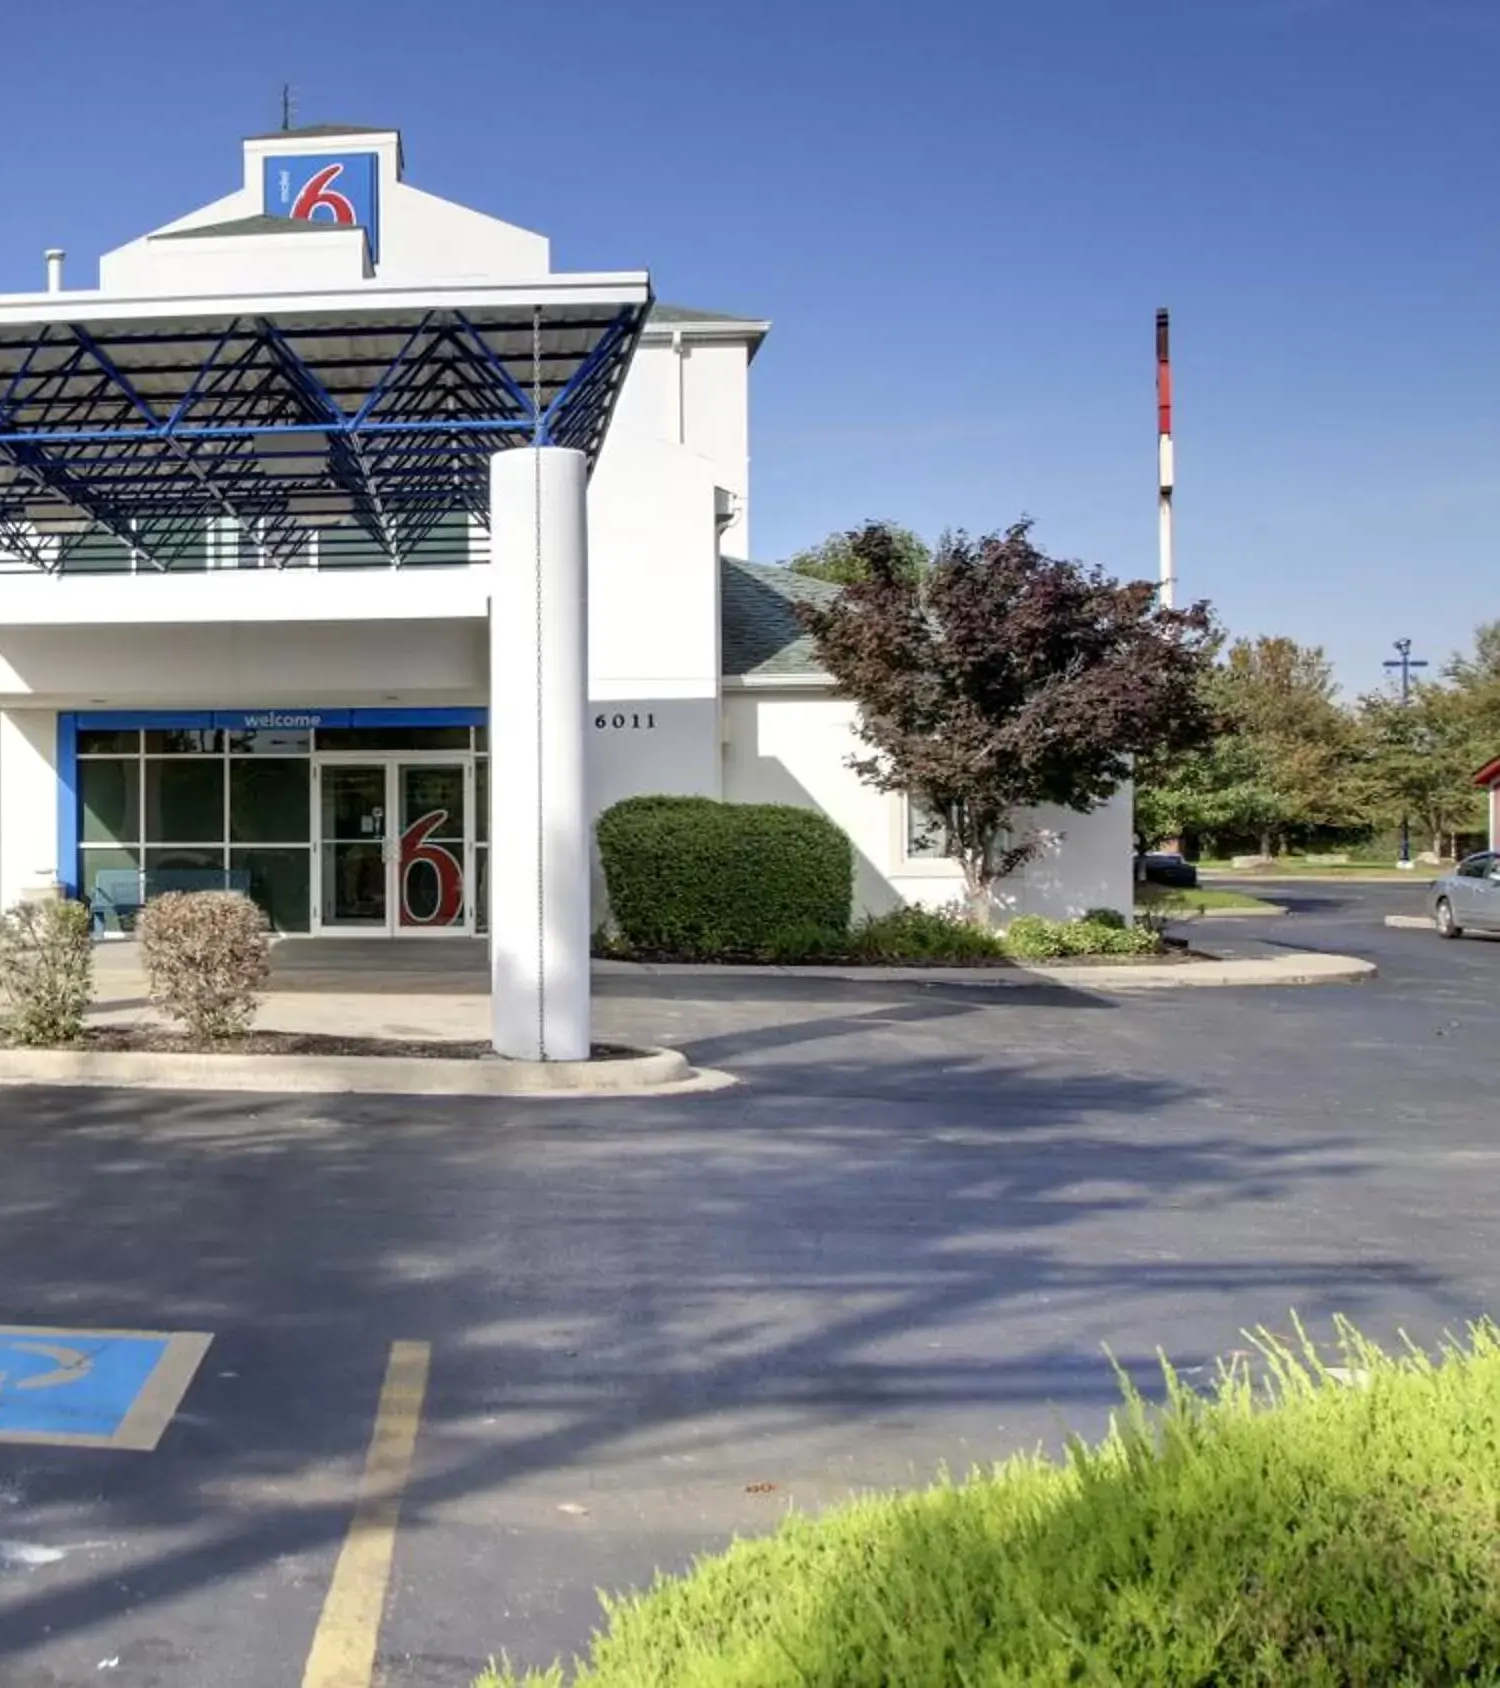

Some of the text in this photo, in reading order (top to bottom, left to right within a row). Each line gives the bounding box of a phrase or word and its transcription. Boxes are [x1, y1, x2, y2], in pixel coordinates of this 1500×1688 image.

[290, 163, 357, 226] 6
[243, 711, 322, 728] welcome
[595, 713, 656, 729] 6011
[398, 809, 463, 927] 6
